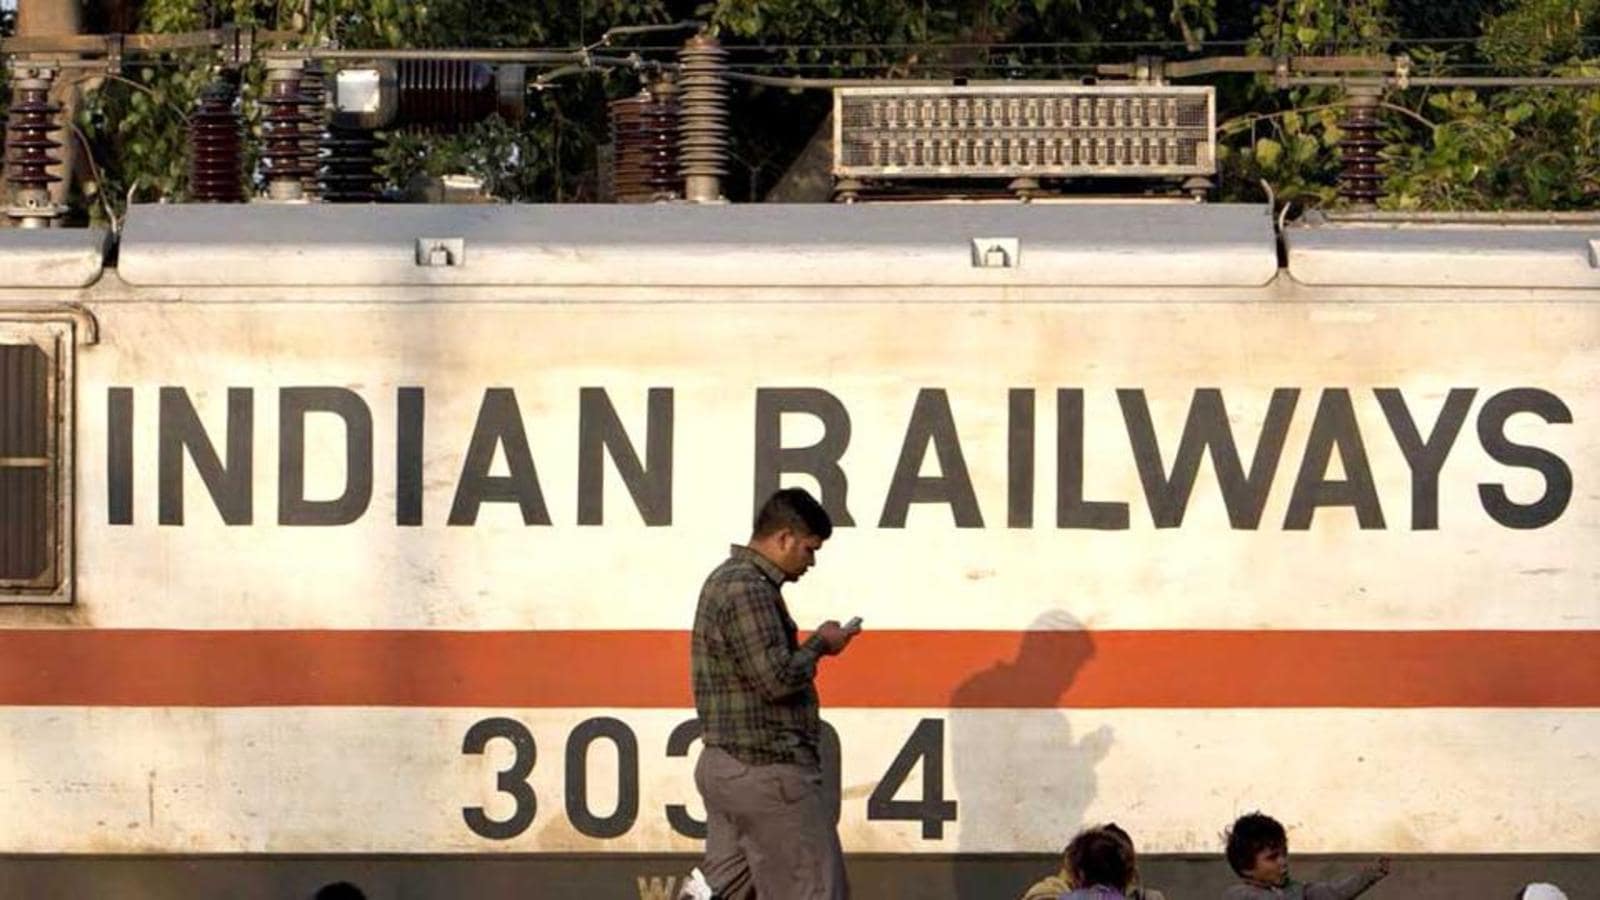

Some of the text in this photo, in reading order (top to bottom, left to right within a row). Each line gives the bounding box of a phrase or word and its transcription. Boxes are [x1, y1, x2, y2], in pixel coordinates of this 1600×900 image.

[107, 386, 1573, 531] INDIAN RAILWAYS
[461, 717, 958, 841] 304
